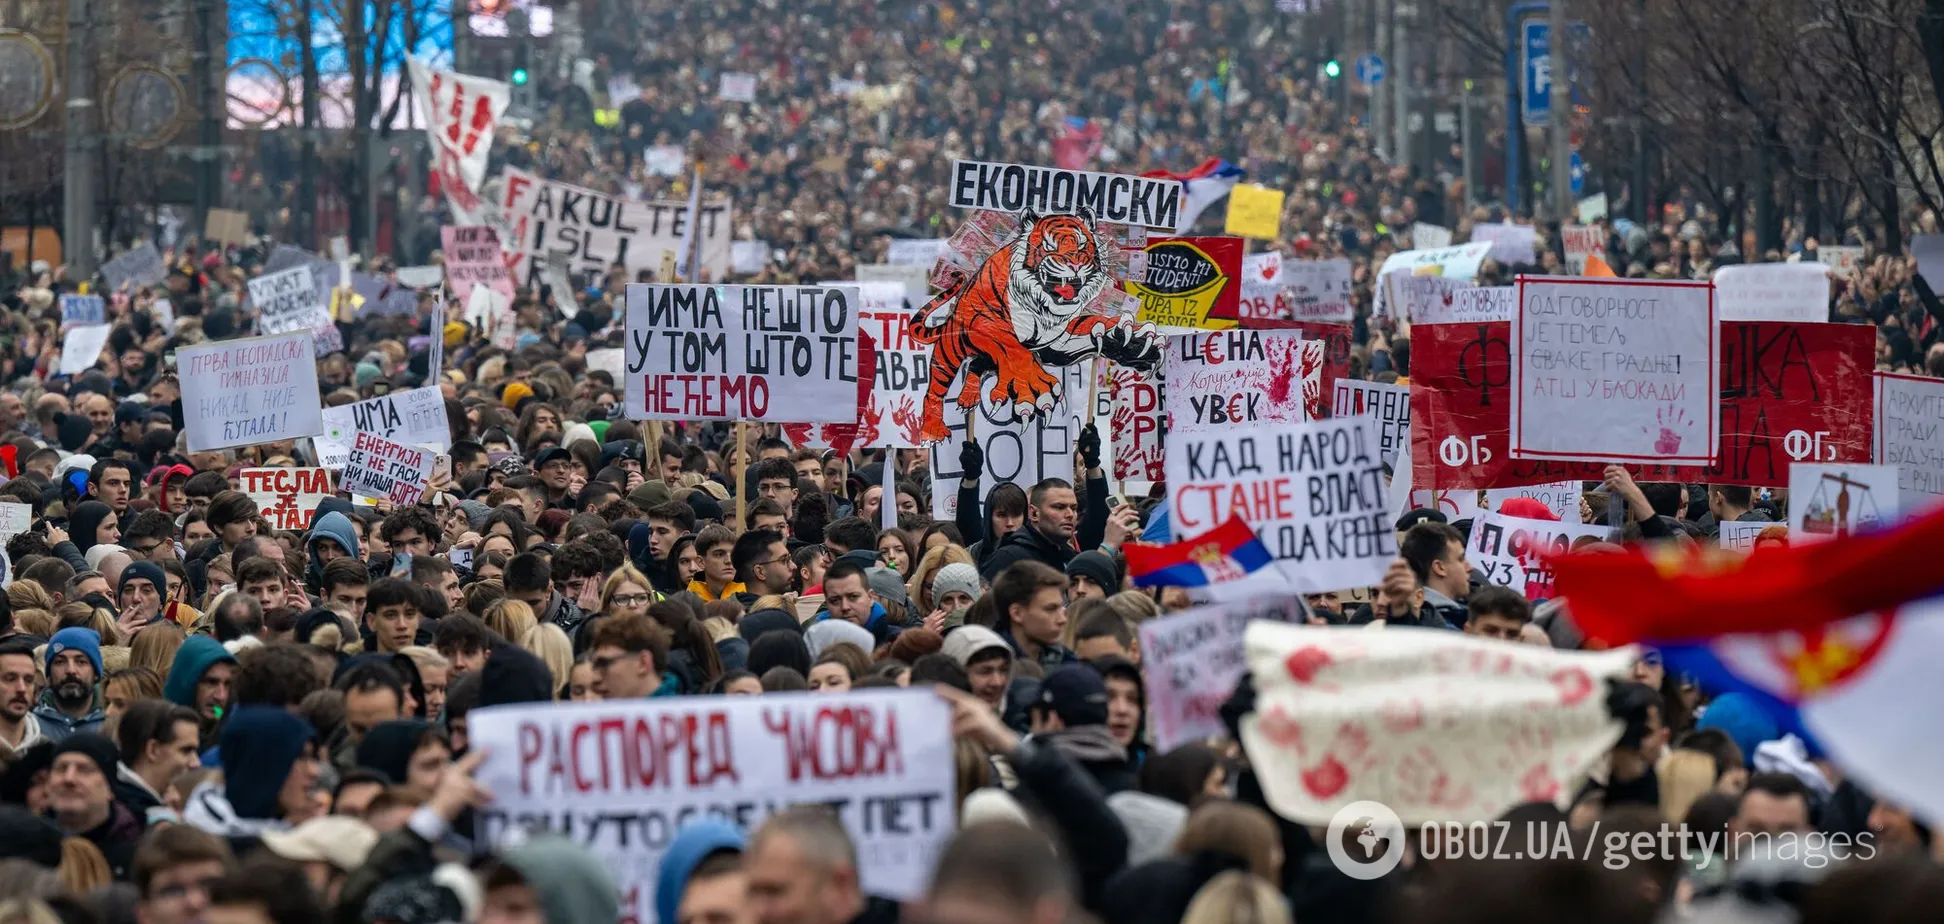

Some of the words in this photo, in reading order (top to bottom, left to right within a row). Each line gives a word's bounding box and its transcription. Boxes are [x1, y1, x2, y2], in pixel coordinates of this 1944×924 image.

[954, 161, 1180, 229] ЕКОНОМСКИ
[1147, 266, 1201, 288] TUDENTI
[1193, 259, 1212, 276] MI
[648, 286, 724, 330] ИМА
[742, 287, 848, 335] НЕШТО
[1182, 298, 1198, 317] IZ
[1528, 294, 1659, 320] ОДГОВОРНОСТ
[1527, 321, 1549, 343] ЈЕ
[1554, 322, 1626, 345] ТЕМЕЉ
[189, 350, 229, 376] ПРВА
[628, 329, 654, 374] У
[662, 330, 727, 373] ТОМ
[745, 332, 813, 378] ШТО
[819, 336, 858, 383] ТЕ
[219, 364, 290, 389] ГИМНАЗИЈА
[1533, 377, 1576, 398] АТШ
[1586, 378, 1598, 398] У
[1602, 379, 1686, 401] БЛОКАДИ
[200, 391, 249, 420] НИКАД
[261, 385, 298, 411] НИЈЕ
[644, 374, 770, 419] НЕЋЕМО
[352, 397, 402, 432] ИМА
[1888, 416, 1938, 441] ГРАДИ
[349, 450, 364, 465] СЕ
[367, 455, 386, 472] НЕ
[355, 431, 422, 469] ЕНЕРГИЈА
[1186, 437, 1263, 481] КАД
[1277, 426, 1370, 473] НАРОД
[241, 468, 331, 494] ТЕСЛА
[344, 464, 363, 482] НИ
[362, 469, 394, 495] НАША
[275, 492, 298, 510] ЈЕ
[1175, 478, 1295, 528] СТАНЕ
[1307, 466, 1384, 518] ВЛАСТ
[1275, 523, 1321, 562] ДА
[517, 710, 740, 796] РАСПОРЕД
[762, 705, 905, 782] ЧАСОВА
[860, 791, 941, 836] ПЕТ
